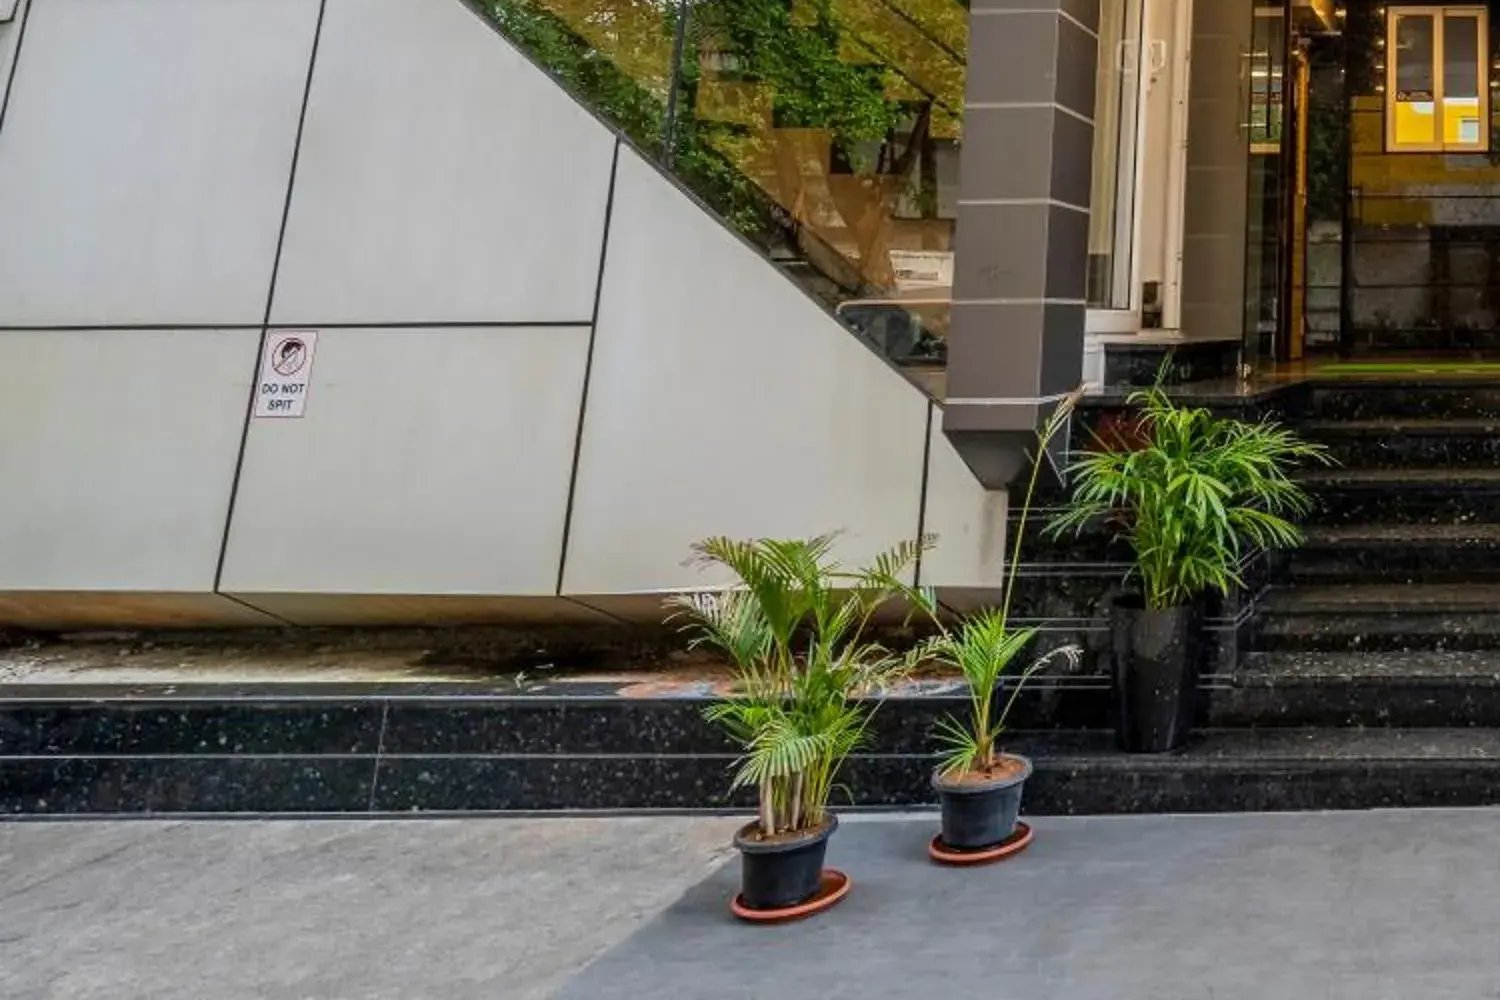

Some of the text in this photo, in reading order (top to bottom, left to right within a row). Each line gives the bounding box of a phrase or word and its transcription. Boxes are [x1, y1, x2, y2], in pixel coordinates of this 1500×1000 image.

[262, 383, 305, 394] DO NOT
[267, 400, 294, 411] SPIT
